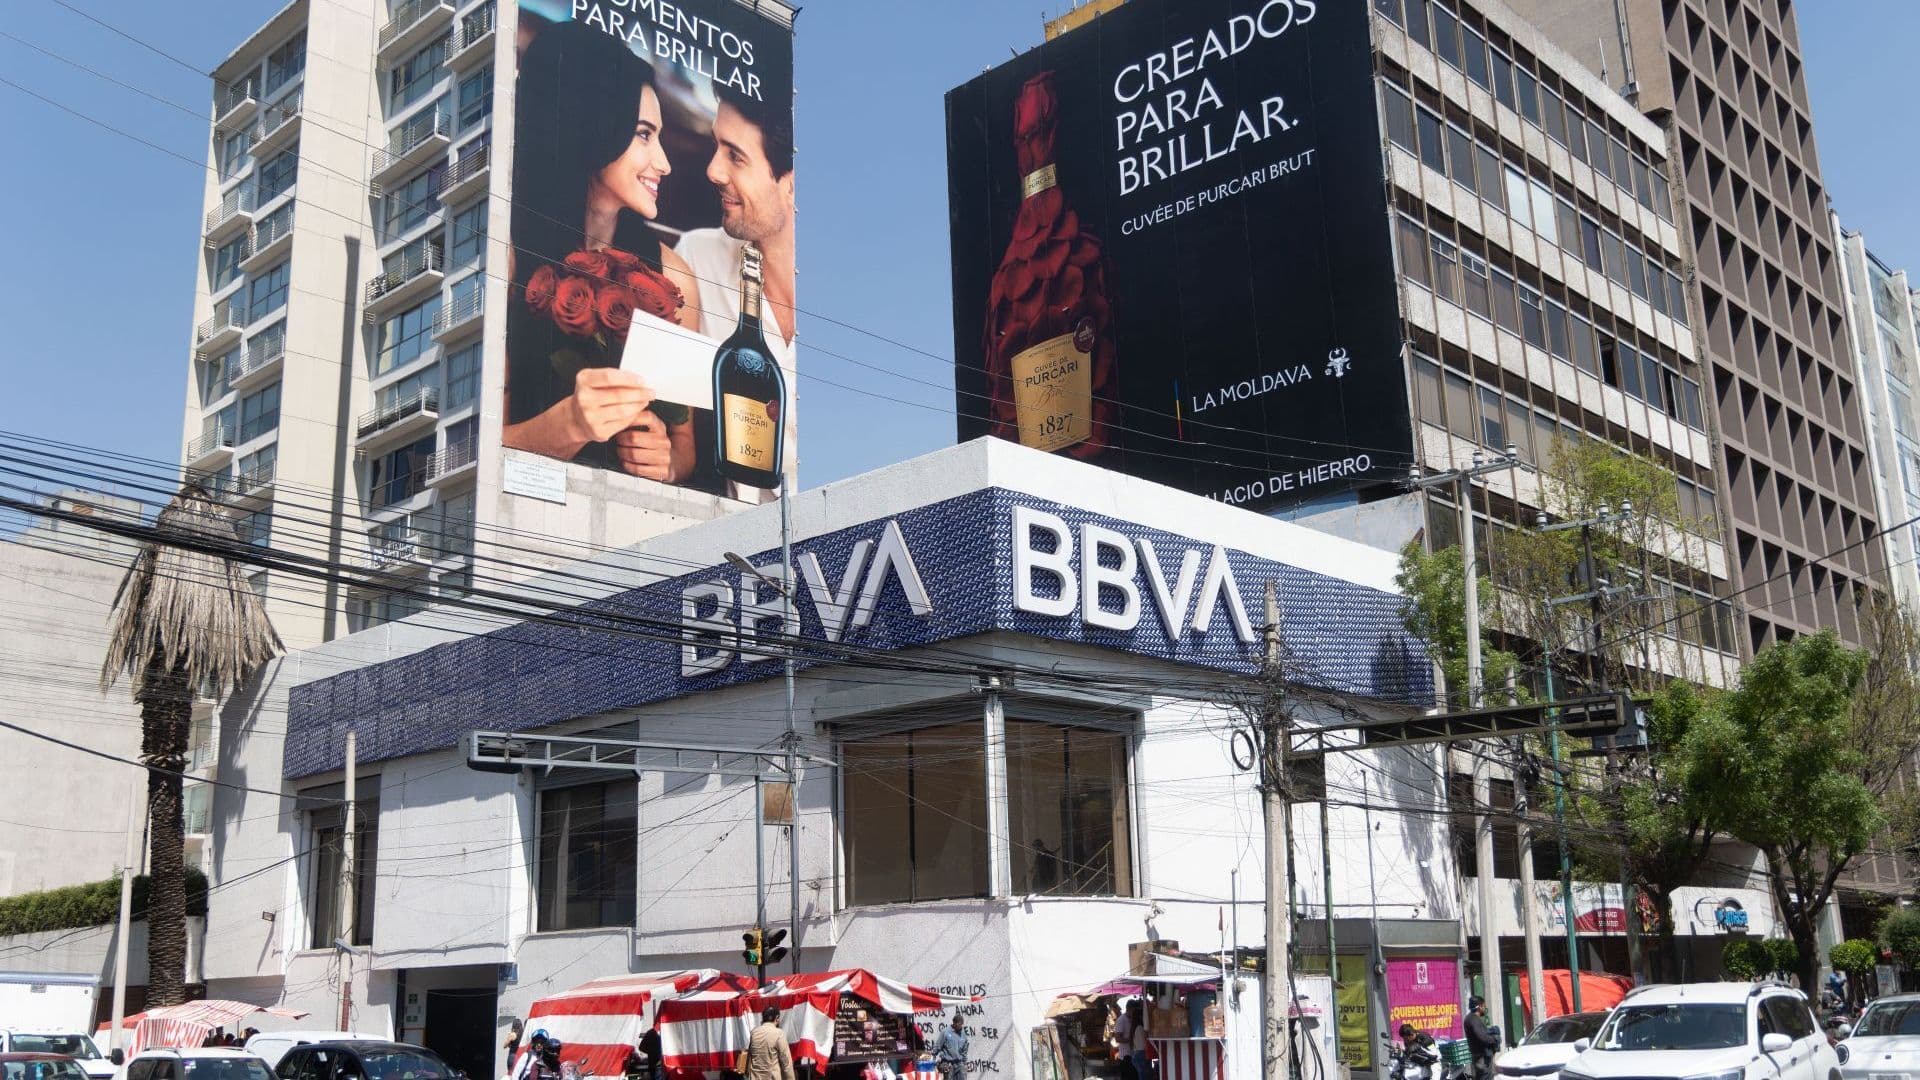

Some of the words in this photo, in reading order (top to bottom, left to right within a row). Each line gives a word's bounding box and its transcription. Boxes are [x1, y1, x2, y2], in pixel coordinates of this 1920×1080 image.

[571, 0, 648, 51] PARA
[655, 30, 764, 101] BRILLAR
[1113, 0, 1317, 103] CREADOS
[1115, 77, 1224, 151] PARA
[1118, 96, 1300, 196] BRILLAR.
[1121, 204, 1174, 236] CUVÉE
[1176, 196, 1196, 215] DE
[1198, 168, 1267, 207] PURCARI
[1270, 149, 1316, 180] BRUT
[1025, 360, 1078, 388] PURCARI
[1192, 392, 1217, 413] LA
[1220, 364, 1312, 405] MOLDAVA
[1039, 413, 1073, 436] 1827
[739, 443, 763, 461] 1827
[1205, 481, 1265, 505] ACIO
[1269, 473, 1295, 495] DE
[1299, 454, 1376, 487] HIERRO.
[681, 519, 934, 678] BBVA
[1012, 504, 1256, 644] BBVA
[955, 1004, 985, 1017] AHORA
[970, 984, 987, 998] LOS
[1425, 1003, 1458, 1017] MEJORES
[981, 1026, 999, 1040] SER
